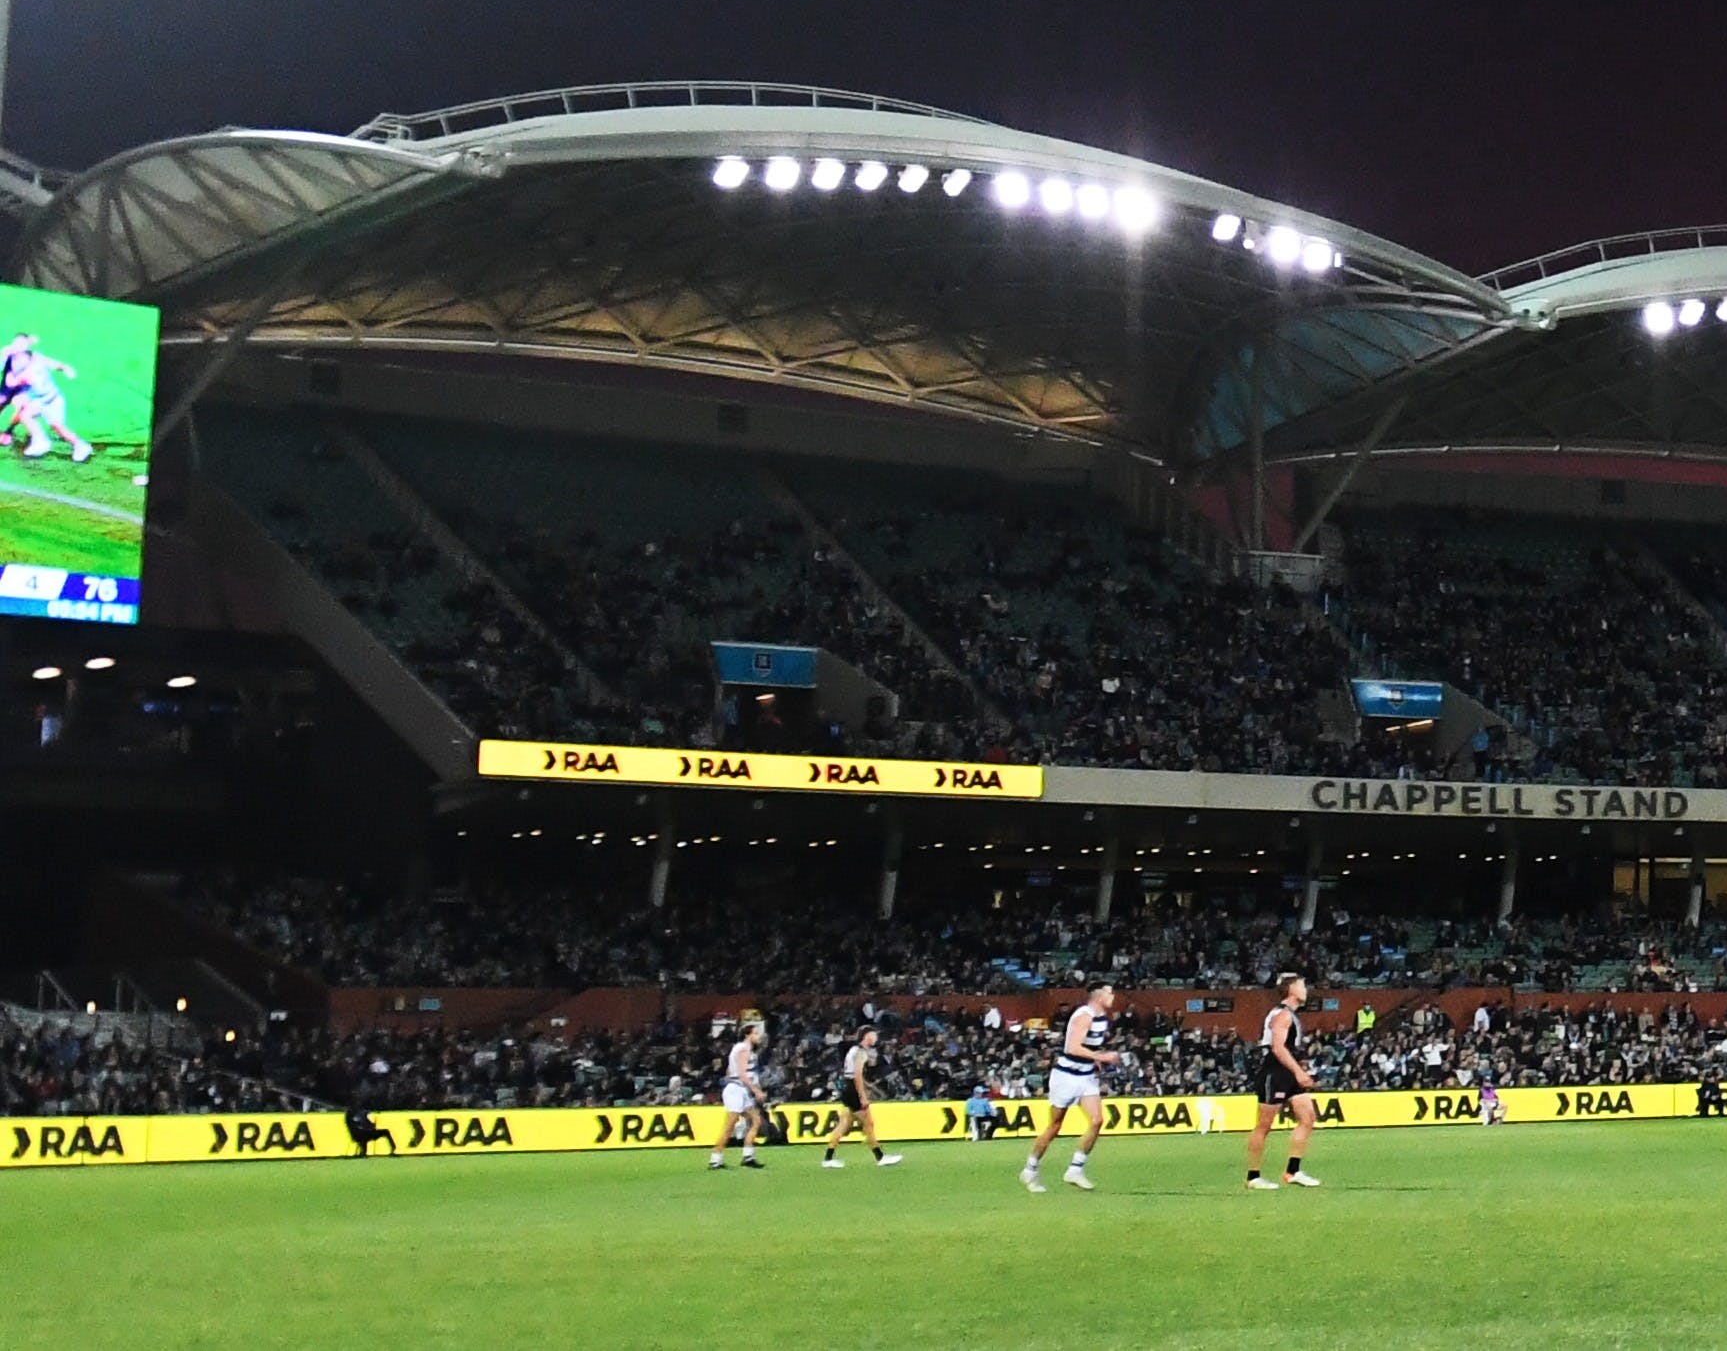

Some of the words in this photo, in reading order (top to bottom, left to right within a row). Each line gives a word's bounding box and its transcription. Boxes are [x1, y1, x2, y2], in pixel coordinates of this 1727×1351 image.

[83, 576, 119, 602] 76
[101, 602, 133, 623] PM
[563, 752, 620, 773] RAA
[698, 756, 754, 779] RAA
[826, 763, 880, 784] RAA
[952, 768, 1004, 790] RAA
[1311, 779, 1535, 816] CHAPPELL
[1554, 789, 1689, 818] STAND
[1128, 1102, 1193, 1130] RAA
[1575, 1090, 1635, 1115] RAA
[434, 1117, 514, 1148] RAA
[621, 1113, 695, 1143] RAA
[965, 1105, 1036, 1133] AA
[38, 1125, 125, 1158] RAA
[236, 1121, 316, 1153] RAA
